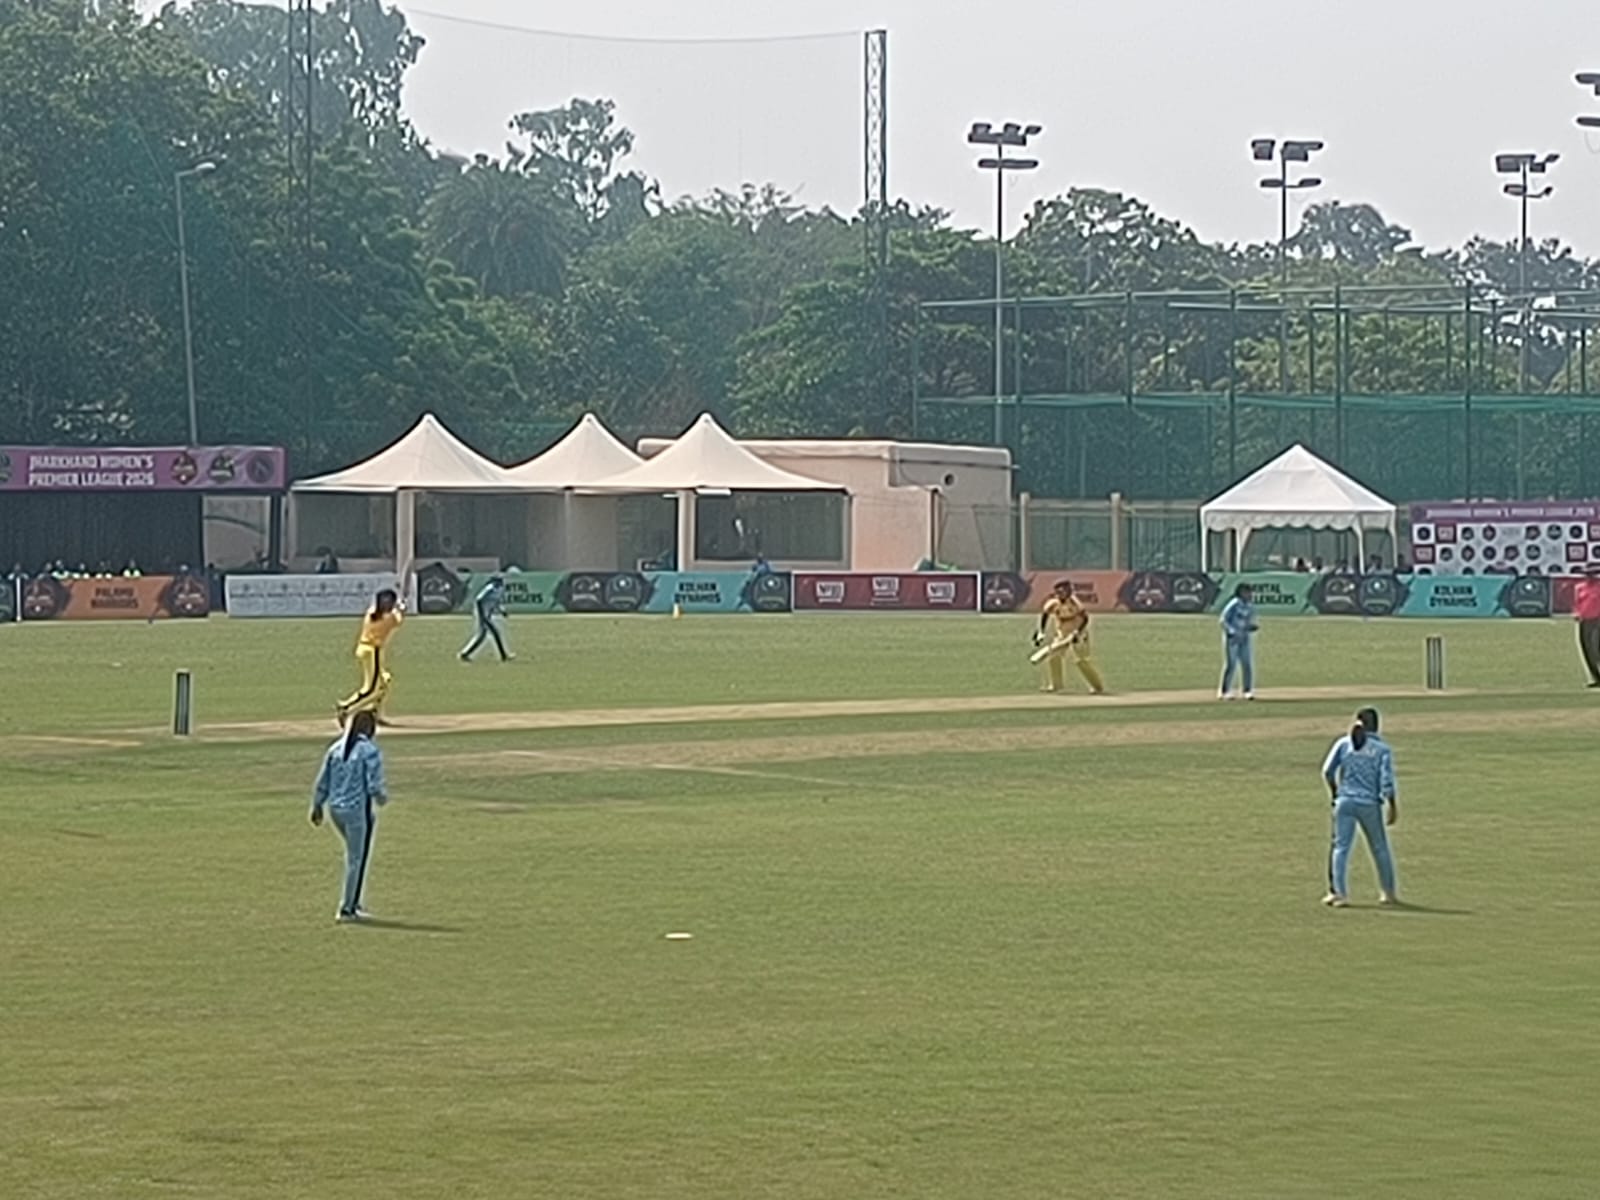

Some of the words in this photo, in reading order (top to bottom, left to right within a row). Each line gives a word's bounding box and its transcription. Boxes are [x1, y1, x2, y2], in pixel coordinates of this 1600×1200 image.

[100, 454, 154, 468] WOMEN'S
[29, 473, 79, 486] PREMIER
[81, 472, 123, 486] LEAGUE
